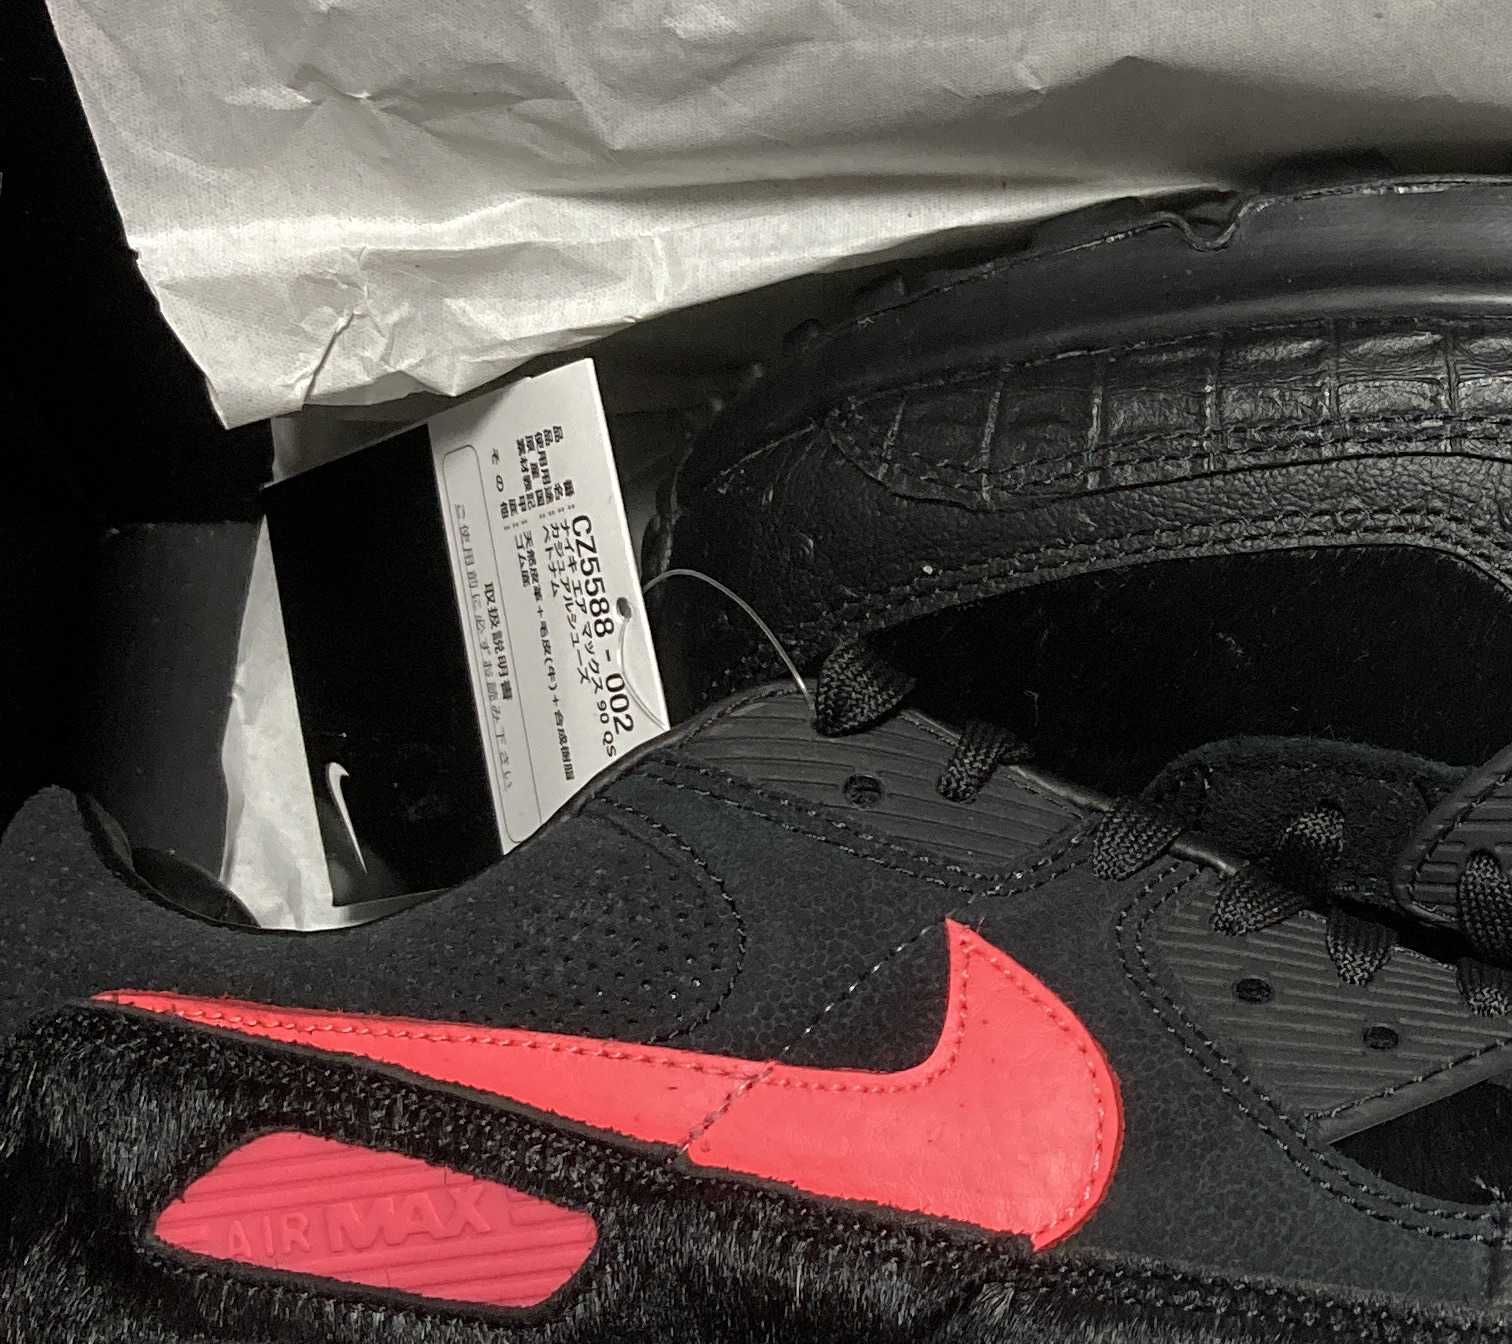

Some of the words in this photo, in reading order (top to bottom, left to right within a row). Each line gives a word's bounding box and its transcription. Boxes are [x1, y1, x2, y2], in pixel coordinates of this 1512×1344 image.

[572, 515, 614, 637] CZ5588
[605, 673, 634, 735] 002
[597, 700, 610, 724] 90
[602, 731, 616, 758] QS
[226, 1211, 312, 1261] AIR
[327, 1185, 493, 1253] MAX
